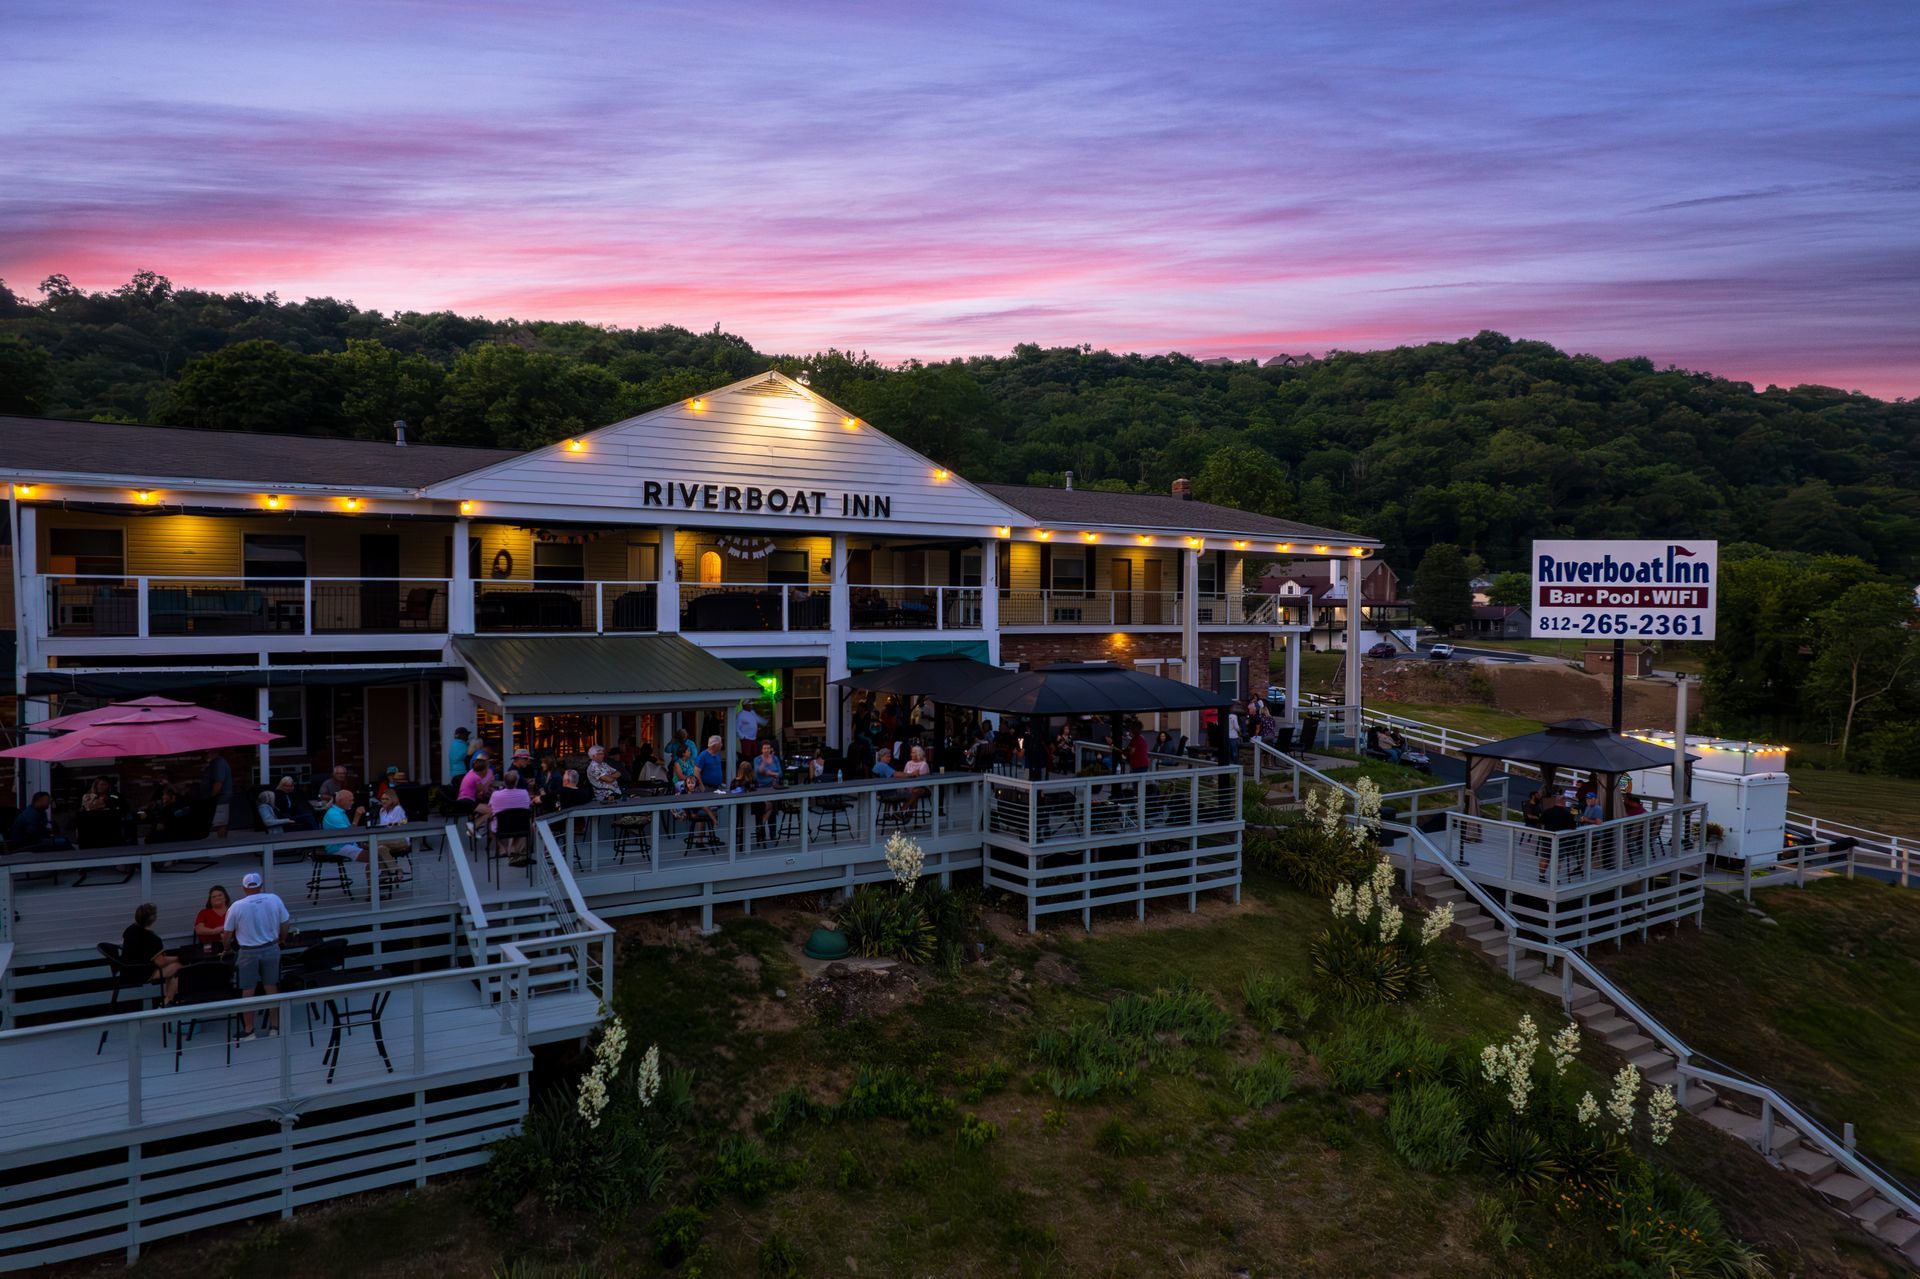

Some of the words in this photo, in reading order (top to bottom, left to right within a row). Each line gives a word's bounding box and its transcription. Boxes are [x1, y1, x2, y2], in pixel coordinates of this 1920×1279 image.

[643, 480, 826, 514] RIVERBOAT
[841, 493, 891, 518] INN
[1538, 554, 1664, 583] Riverboat
[1666, 545, 1710, 583] Inn
[1550, 589, 1585, 604] Bar
[1596, 589, 1639, 605] Pool
[1652, 590, 1698, 605] WIFI
[1539, 613, 1704, 636] 812-265-2361
